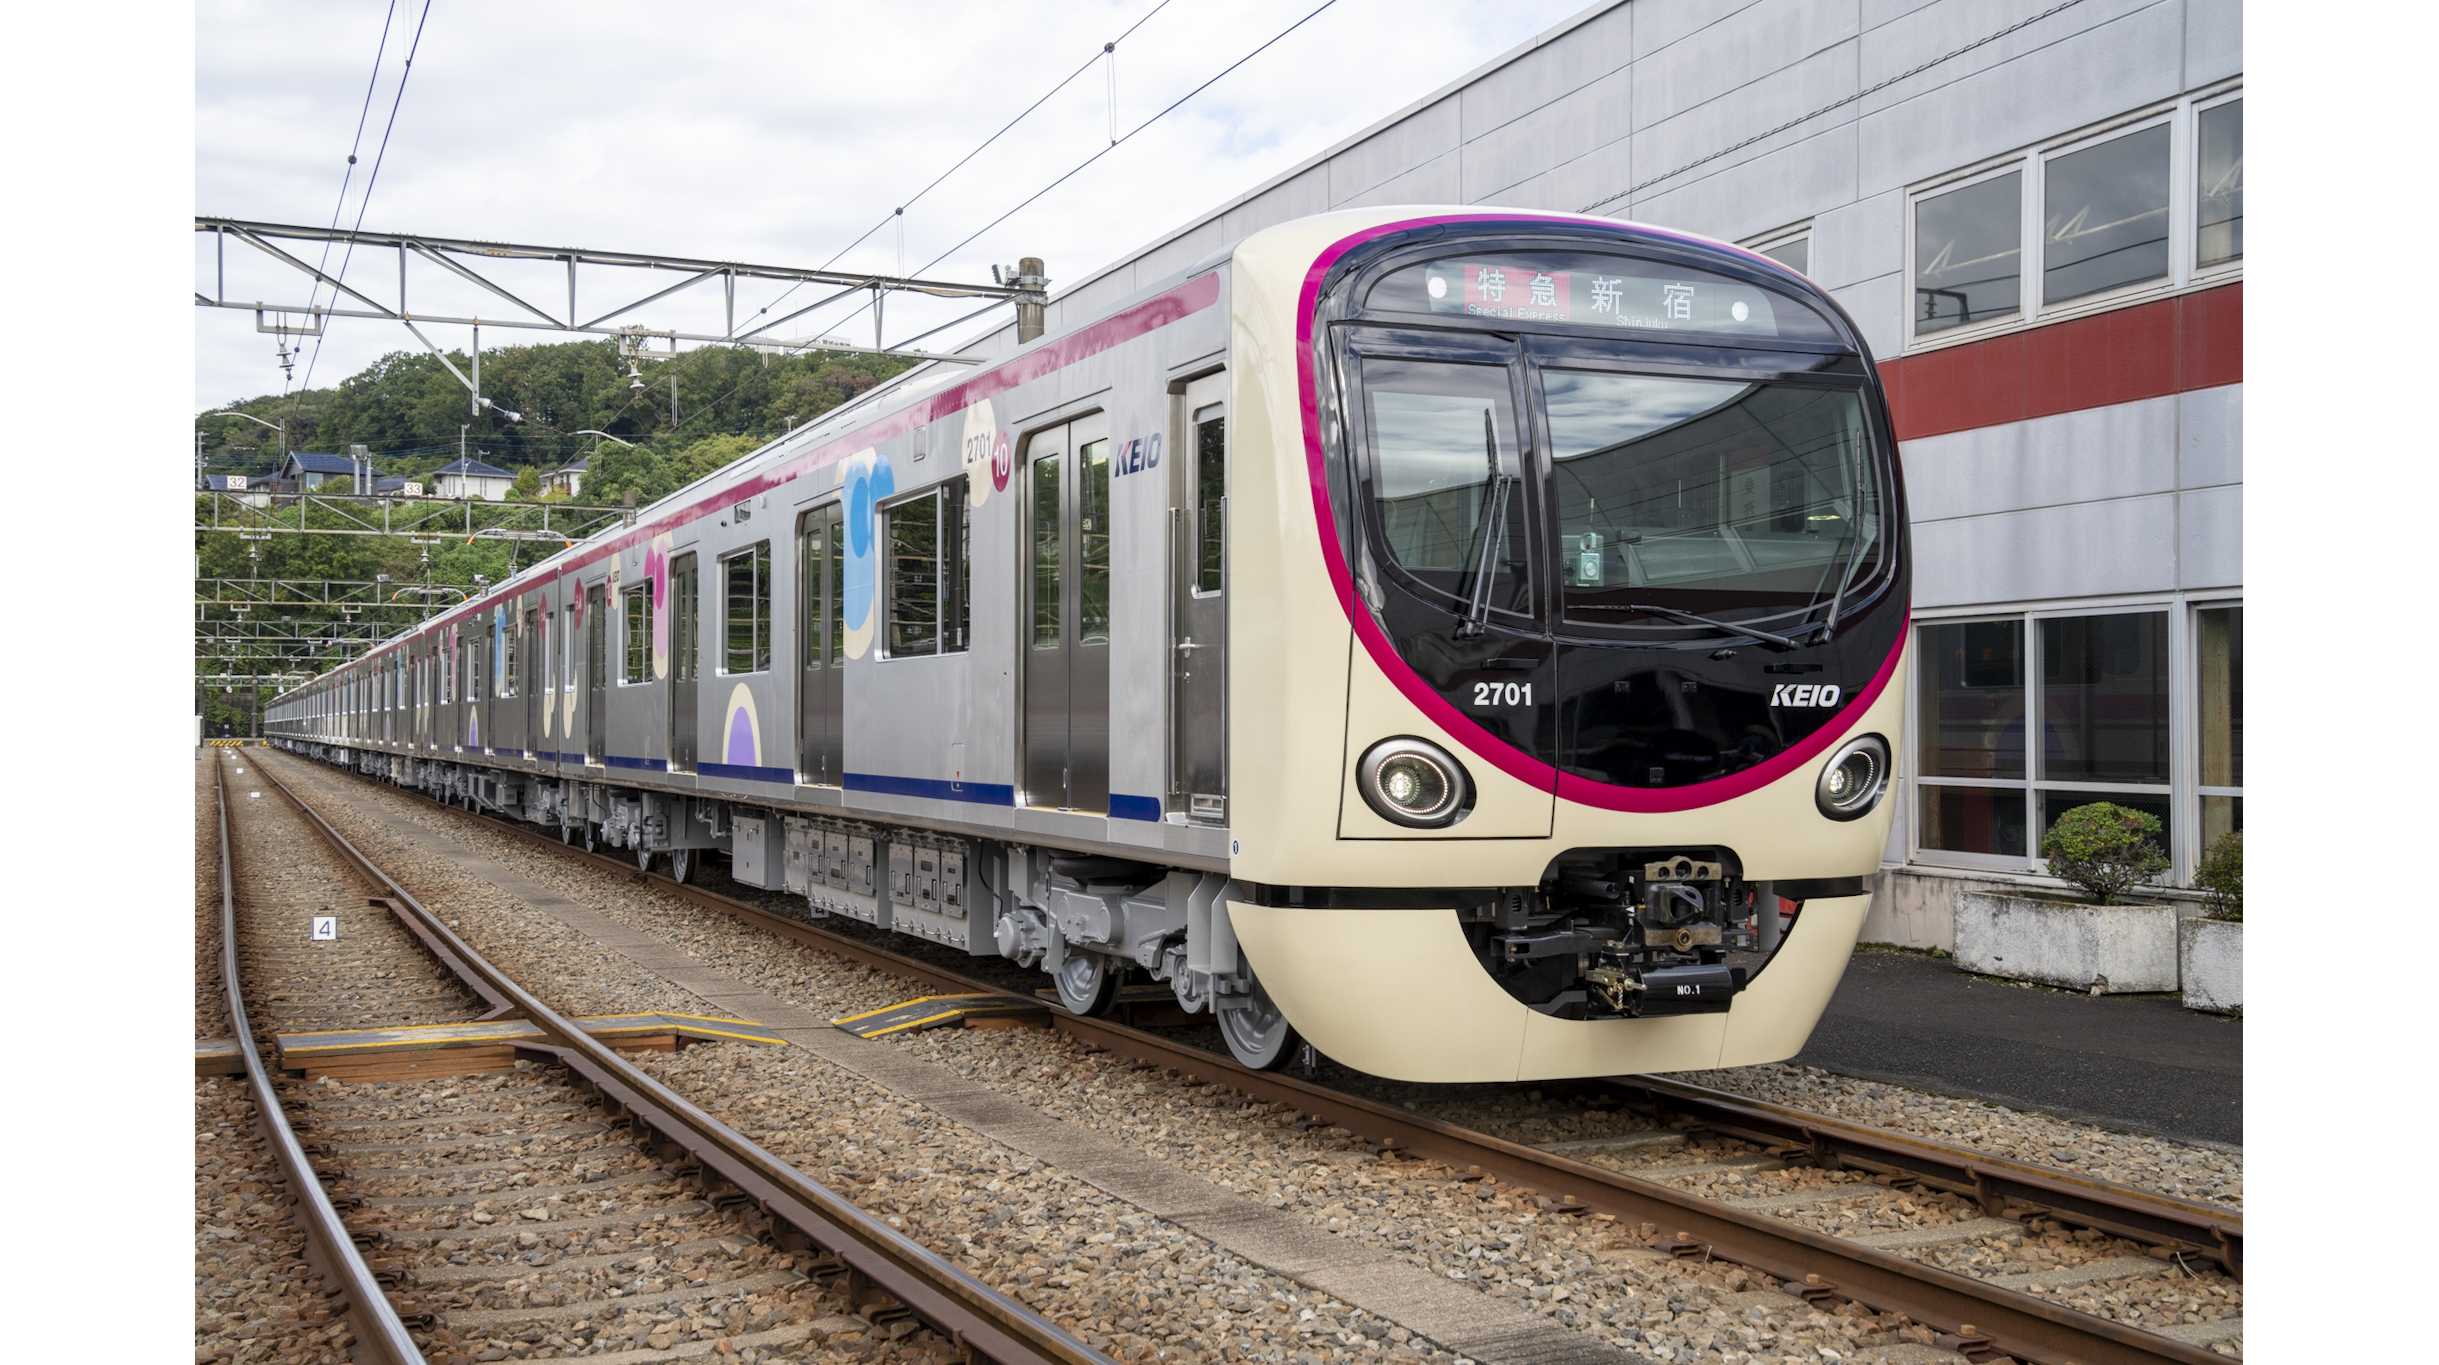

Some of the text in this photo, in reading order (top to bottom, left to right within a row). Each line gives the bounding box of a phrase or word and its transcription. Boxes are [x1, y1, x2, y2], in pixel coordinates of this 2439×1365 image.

[1478, 268, 1695, 320] 特急 新宿
[967, 432, 1009, 478] 2701 10
[1114, 432, 1163, 478] KEIO
[229, 476, 246, 488] 32
[405, 482, 422, 495] 33
[1473, 682, 1533, 706] 2701
[1769, 683, 1842, 707] KEIO
[319, 920, 331, 937] 4
[1676, 984, 1701, 996] NO.1
